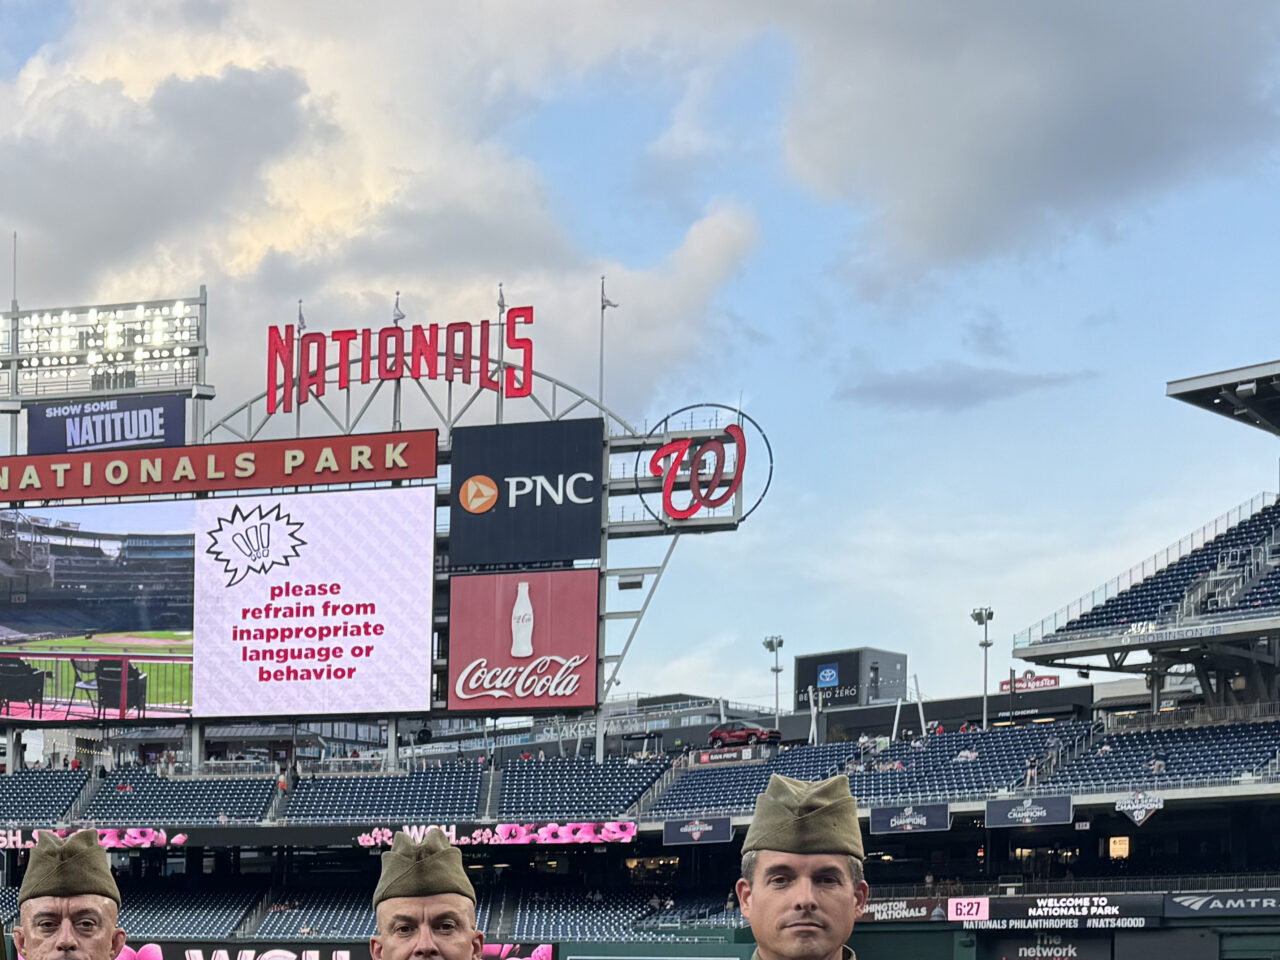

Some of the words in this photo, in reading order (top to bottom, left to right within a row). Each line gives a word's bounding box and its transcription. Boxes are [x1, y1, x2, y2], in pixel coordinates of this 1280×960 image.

[267, 306, 534, 414] NATIONALS
[45, 403, 83, 418] SHOW
[84, 399, 118, 414] SOME
[66, 407, 165, 447] NATITUDE
[284, 442, 409, 475] PARK
[503, 472, 595, 508] PNC
[270, 581, 342, 601] please
[241, 602, 315, 620] refrain
[321, 600, 376, 617] from
[232, 621, 385, 643] inappropriate
[1138, 627, 1204, 643] ROBINSON
[242, 645, 344, 664] language
[350, 644, 374, 657] or
[258, 664, 357, 682] behavior
[798, 690, 833, 702] BEOND
[834, 687, 857, 699] ZERO
[1002, 682, 1027, 691] RAING
[1008, 809, 1047, 819] CHAMPIONS
[1115, 801, 1164, 811] CHAMPIONS
[955, 901, 981, 917] 6:27
[1036, 897, 1090, 908] WELCOME
[1092, 896, 1108, 906] TO
[1208, 898, 1280, 909] AMTR
[874, 906, 927, 921] NATIONALS
[1028, 906, 1089, 917] NATIONALS
[1090, 905, 1120, 916] PARK
[963, 919, 1007, 930] NATIONALS
[1008, 918, 1079, 930] PHILANTHROPIES
[1086, 917, 1145, 928] #NATS4GOOD
[1034, 932, 1062, 945] The
[1018, 944, 1078, 957] network
